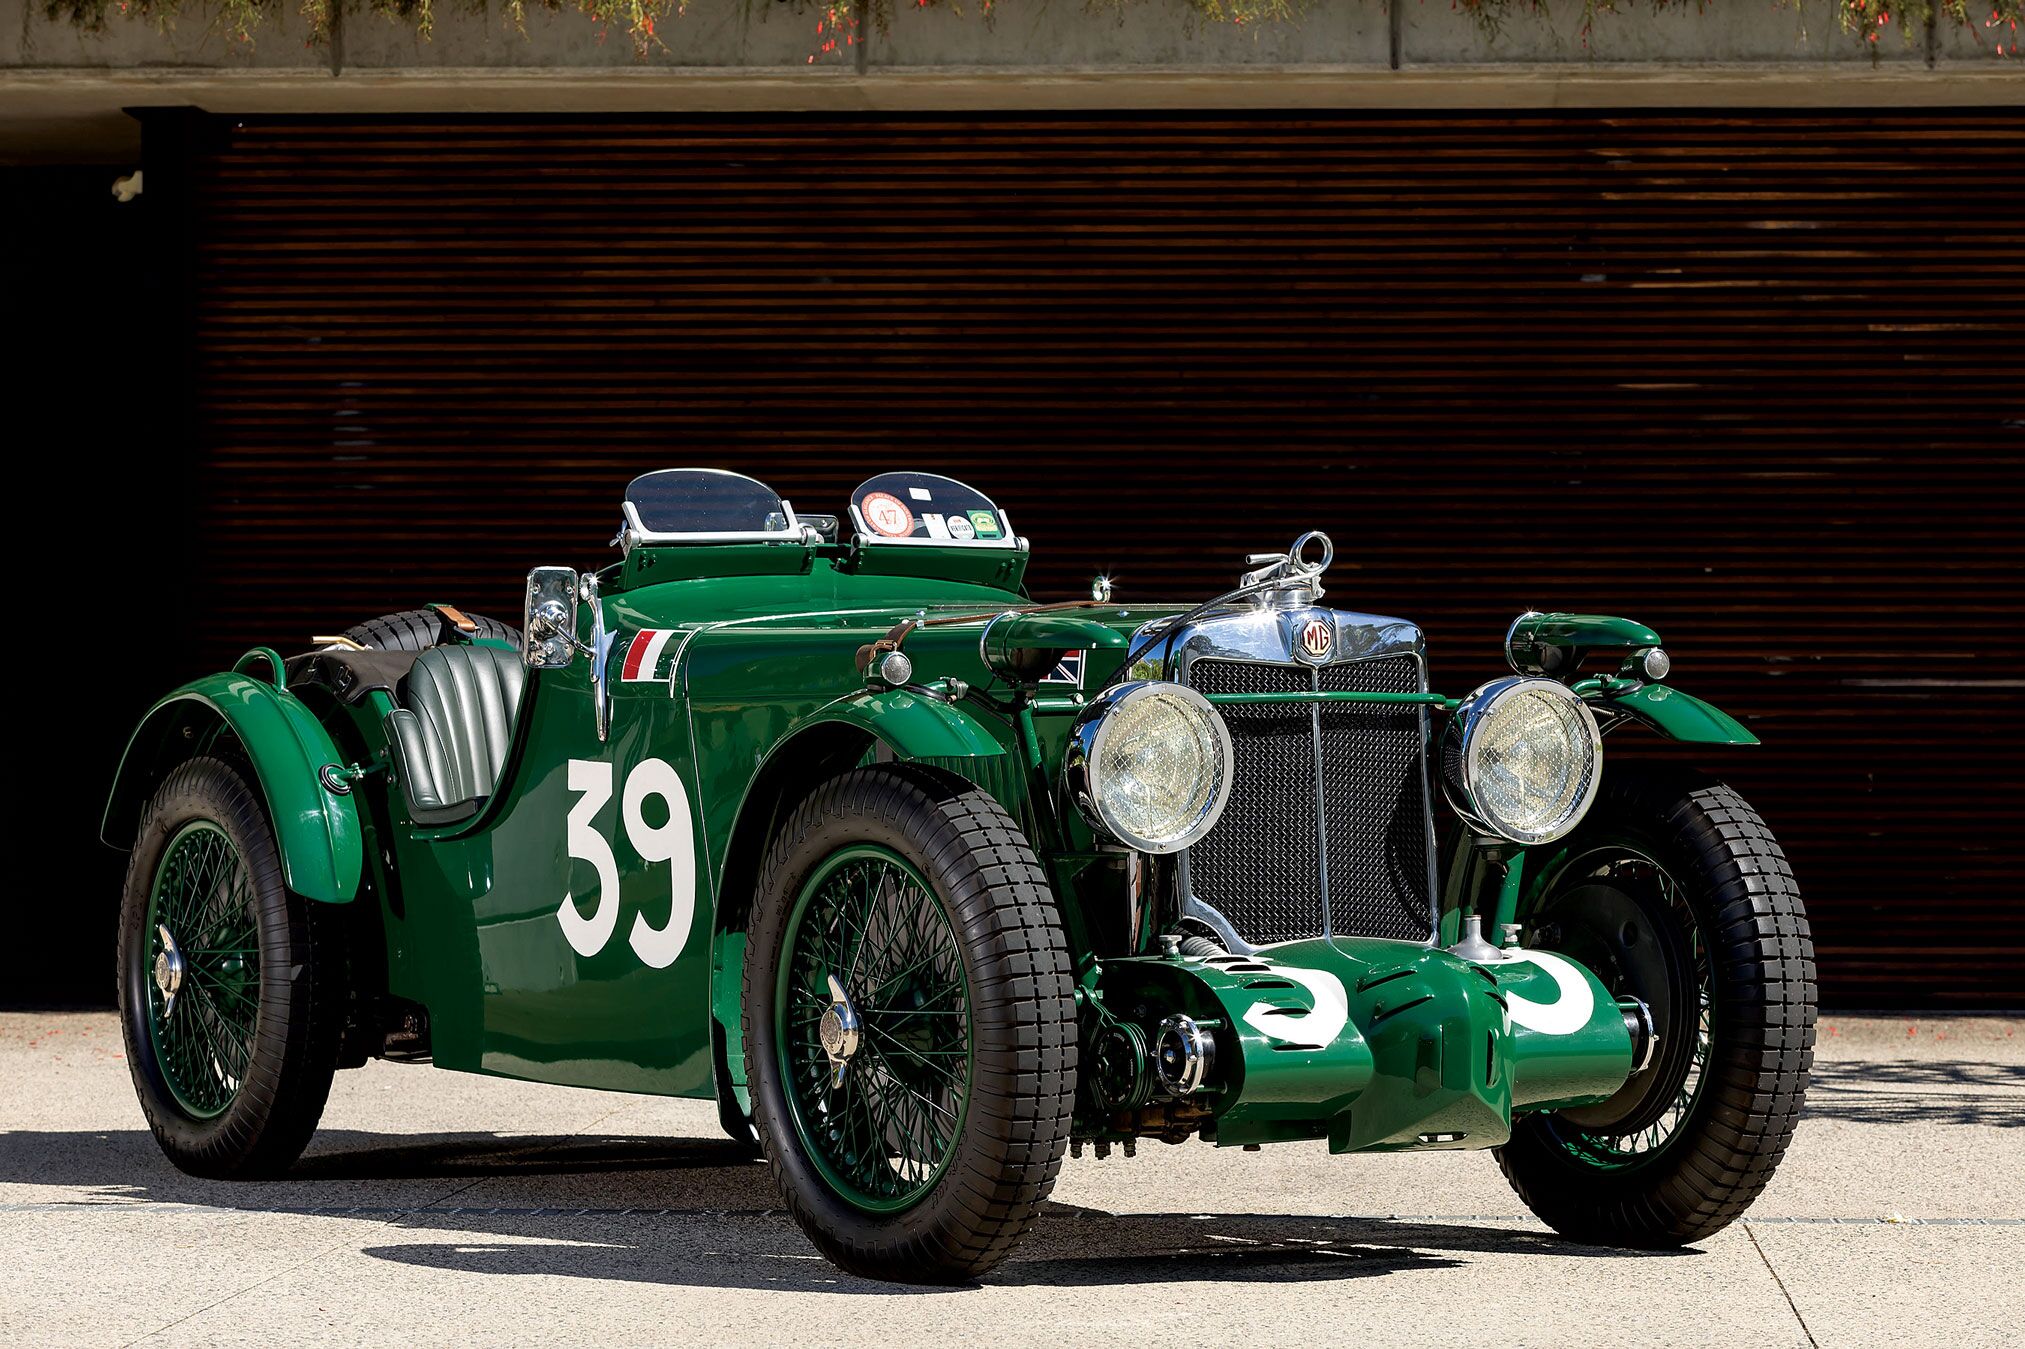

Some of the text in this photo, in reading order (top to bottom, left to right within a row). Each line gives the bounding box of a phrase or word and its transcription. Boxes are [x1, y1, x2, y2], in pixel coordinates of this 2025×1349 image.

[878, 509, 897, 525] 47
[1307, 625, 1329, 651] MG
[556, 757, 696, 969] 39
